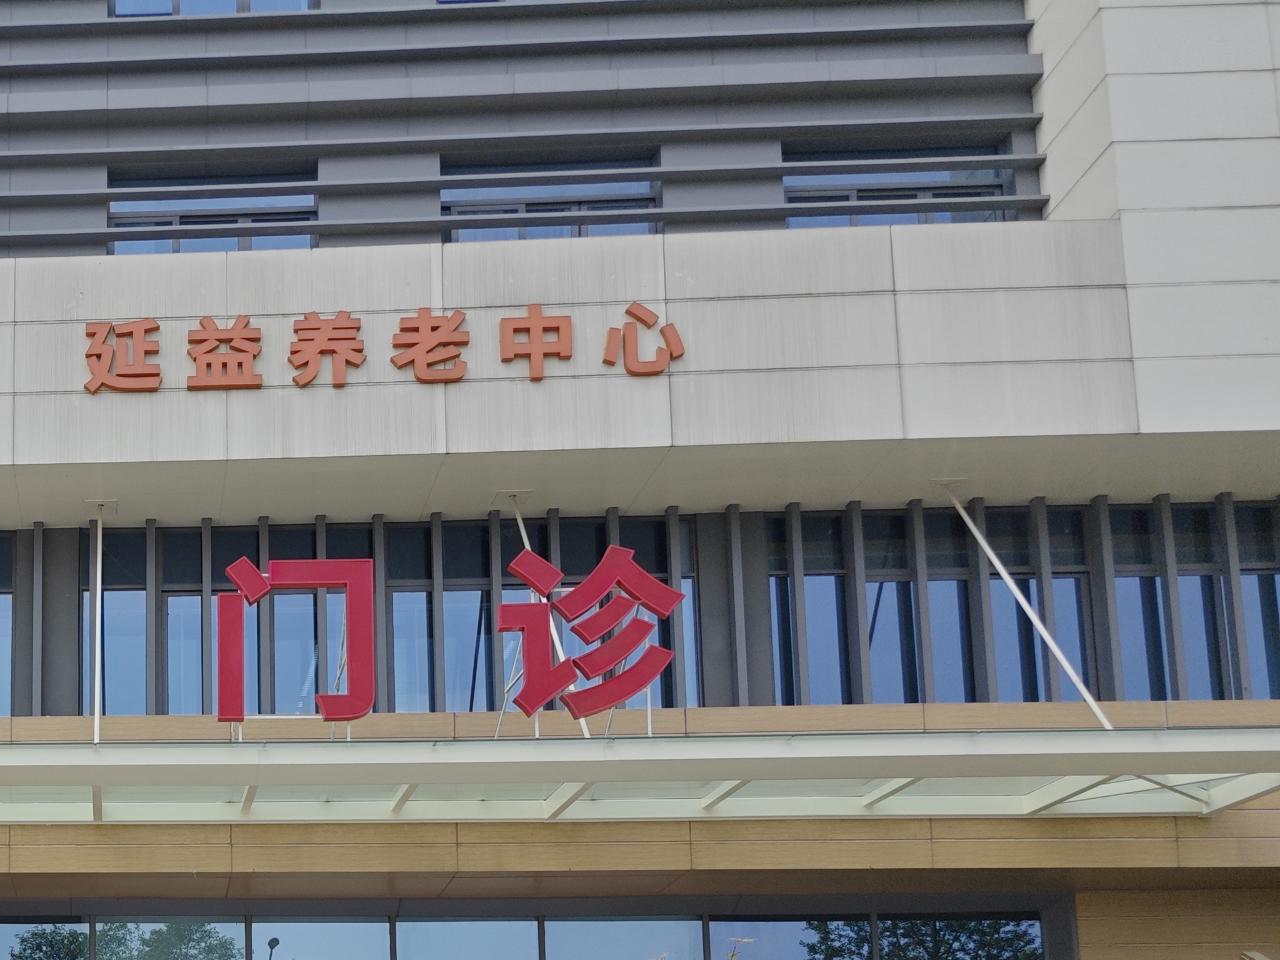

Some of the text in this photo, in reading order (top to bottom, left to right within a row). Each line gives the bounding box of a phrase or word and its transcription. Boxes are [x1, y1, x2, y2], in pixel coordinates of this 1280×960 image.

[84, 302, 686, 394] 延益养老中心
[217, 544, 686, 722] 门诊
